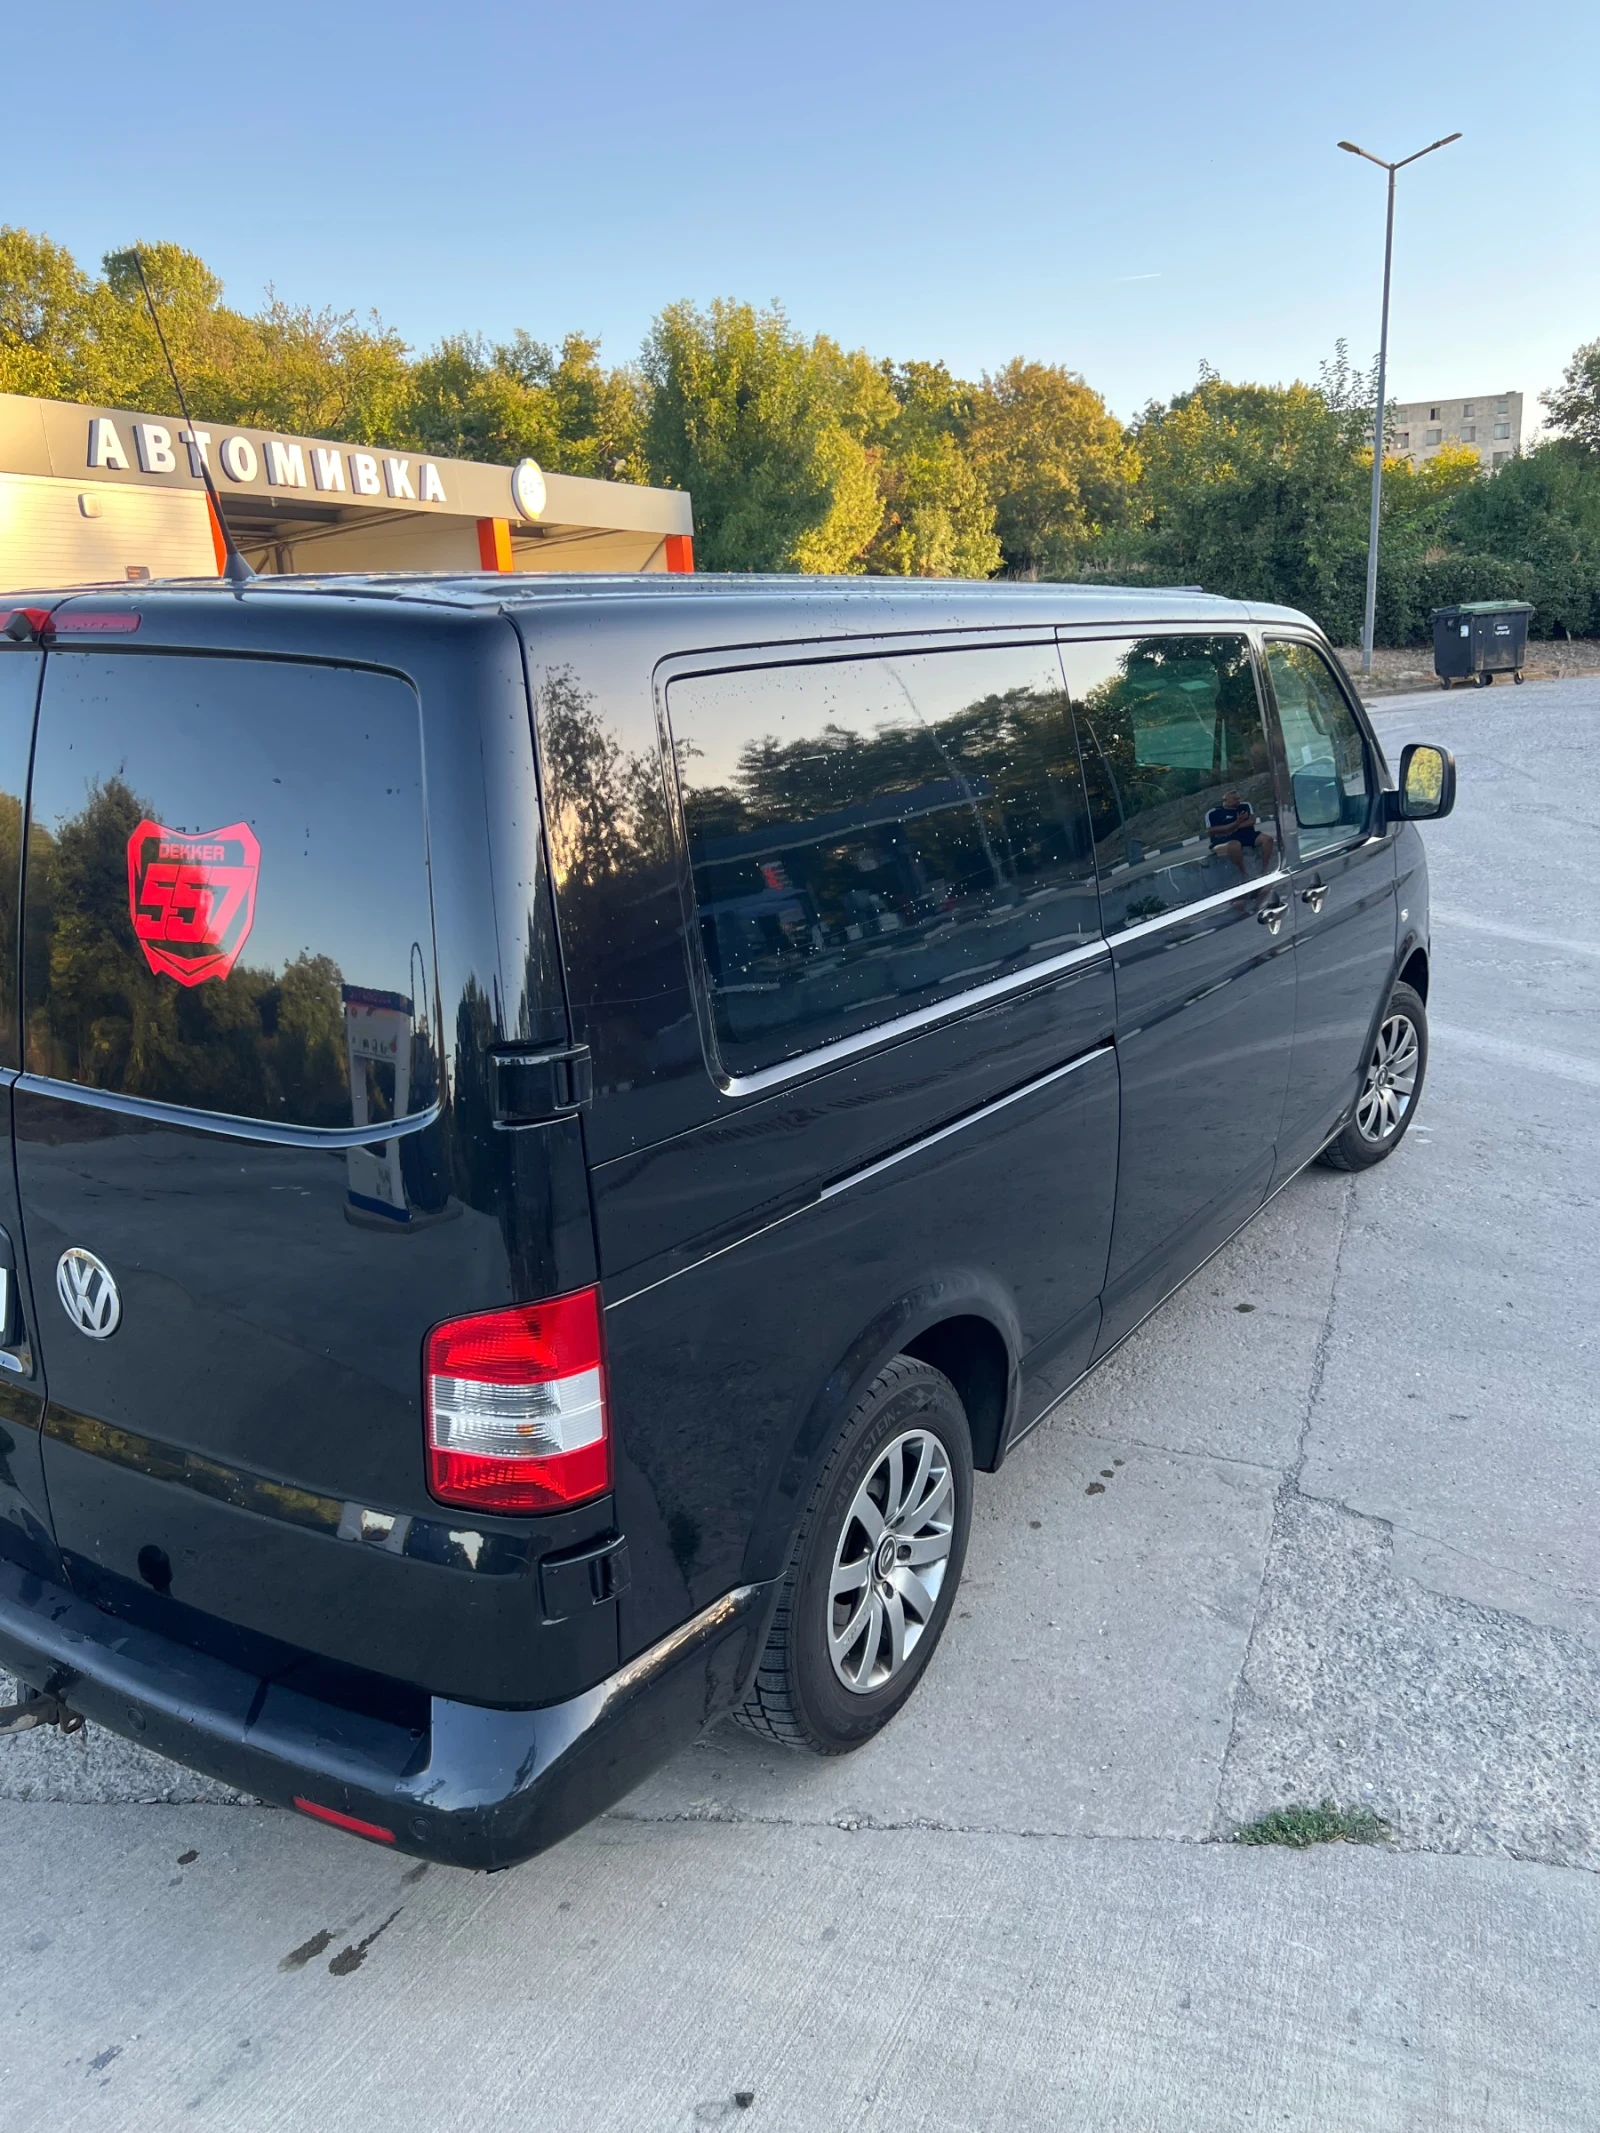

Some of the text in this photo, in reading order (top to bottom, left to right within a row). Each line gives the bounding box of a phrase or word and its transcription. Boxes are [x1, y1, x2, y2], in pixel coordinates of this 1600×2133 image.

[87, 418, 447, 502] АВТОМИВКА
[158, 843, 225, 861] DEKKER
[135, 863, 255, 944] 557
[828, 1406, 897, 1526] VREDESTEIN
